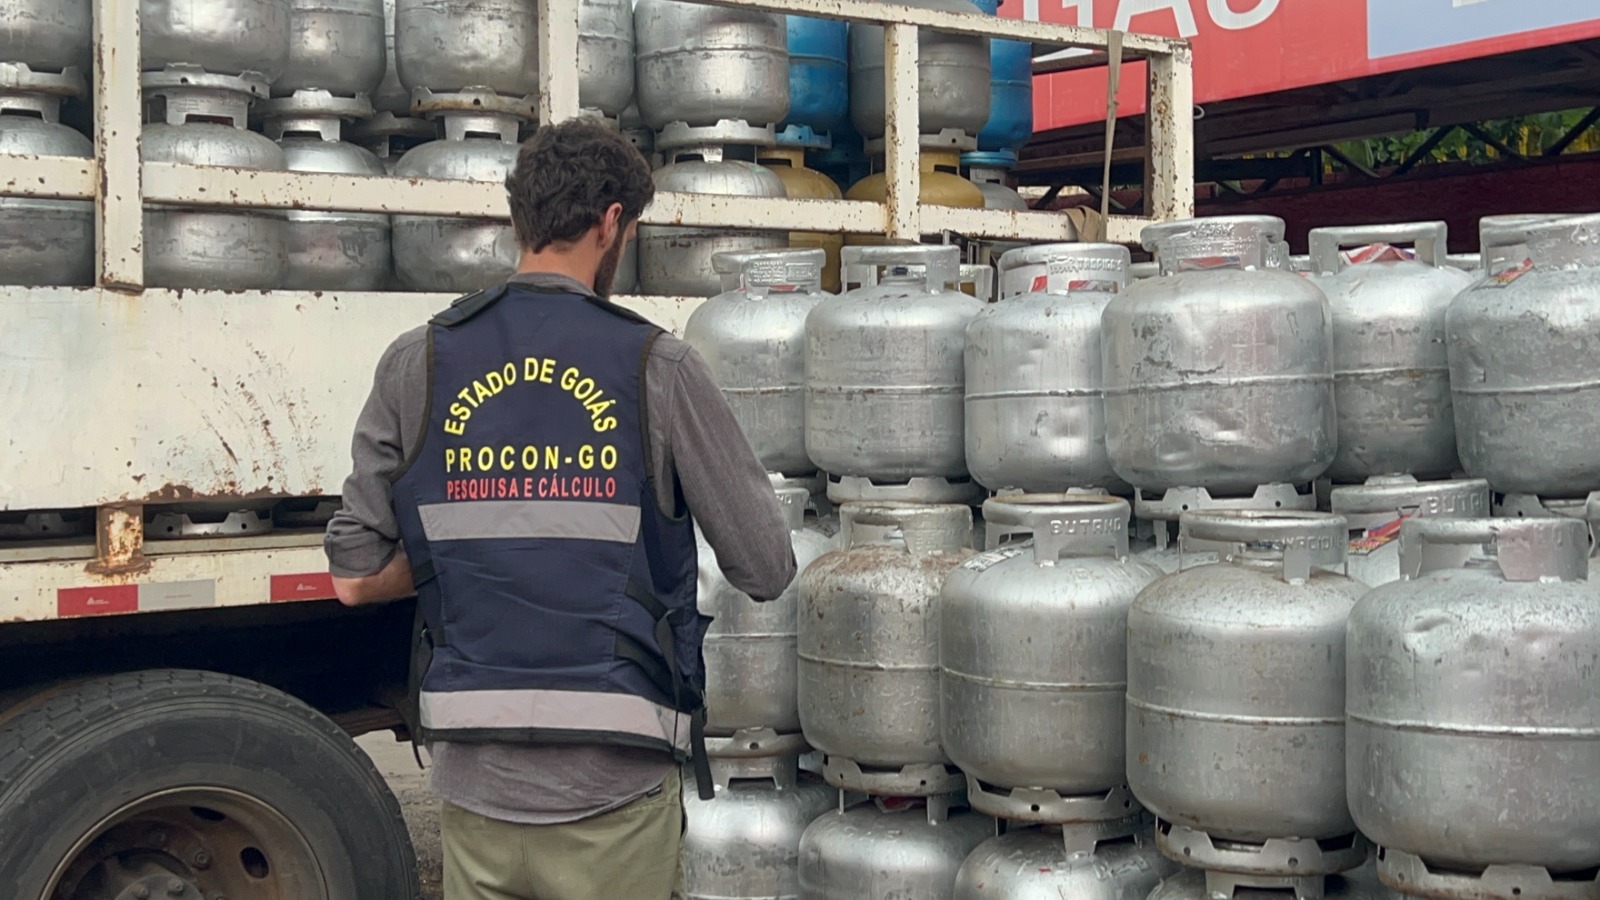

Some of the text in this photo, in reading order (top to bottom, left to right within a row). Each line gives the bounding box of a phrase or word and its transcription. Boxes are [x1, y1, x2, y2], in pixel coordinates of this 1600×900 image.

[444, 357, 618, 436] ESTADO DE GOIÁS
[445, 444, 618, 473] PROCON-GO
[446, 472, 617, 501] PESQUISA E CÁLCULO
[1050, 517, 1121, 536] BUTANO
